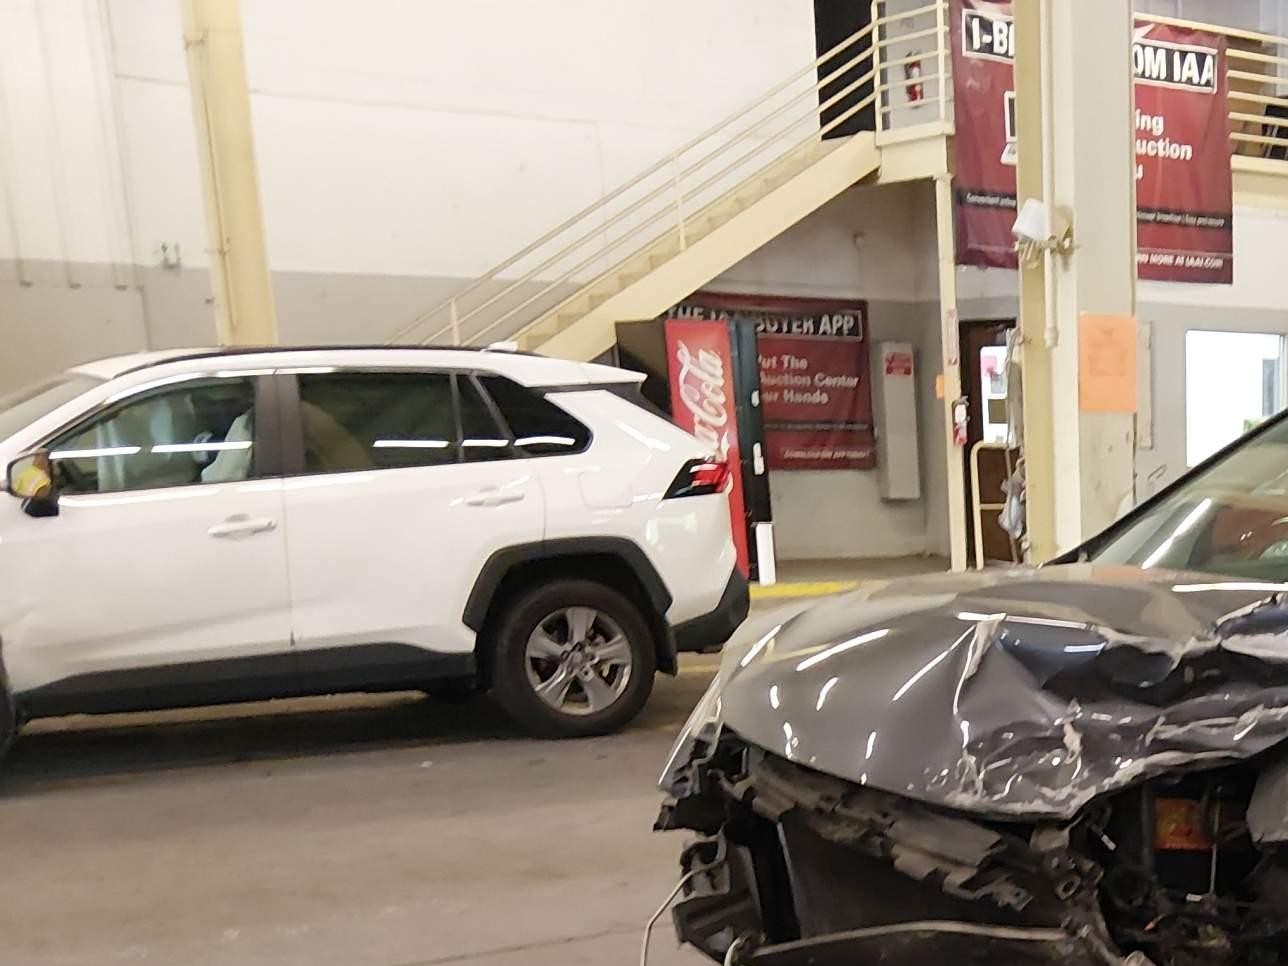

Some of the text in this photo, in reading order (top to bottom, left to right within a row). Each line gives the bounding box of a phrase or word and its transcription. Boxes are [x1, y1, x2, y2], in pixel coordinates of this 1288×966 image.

[972, 17, 1213, 85] I-B OM IAA
[1135, 108, 1164, 136] ing
[1136, 137, 1193, 160] uction
[819, 314, 855, 336] APP
[781, 354, 808, 370] The
[814, 371, 860, 388] Center
[784, 389, 829, 405] Hands
